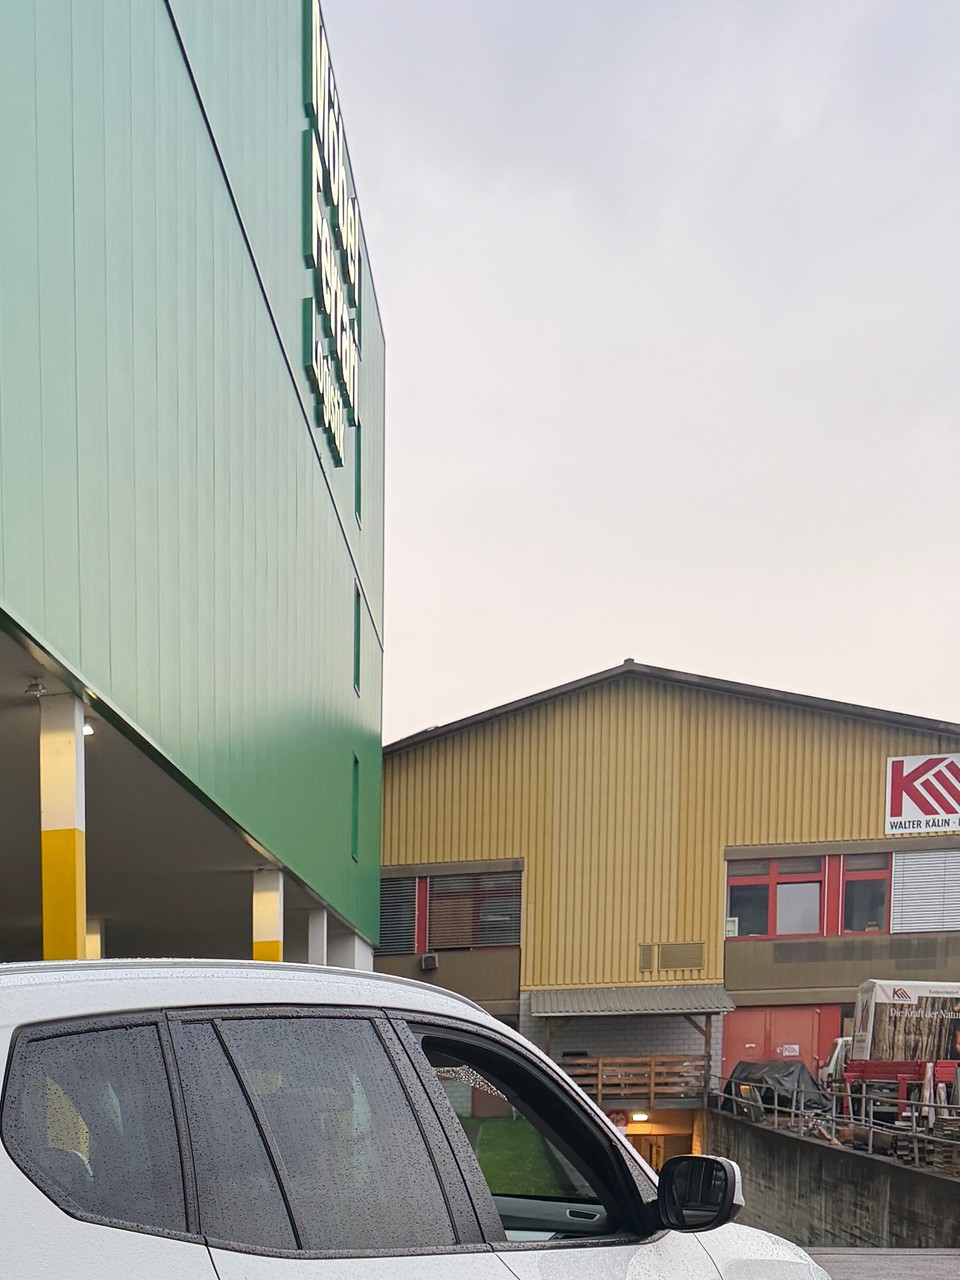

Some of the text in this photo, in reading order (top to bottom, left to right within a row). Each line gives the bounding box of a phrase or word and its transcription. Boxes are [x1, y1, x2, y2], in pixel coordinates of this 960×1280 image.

[312, 0, 359, 307] Möbel
[312, 130, 359, 426] Ferrari
[312, 298, 345, 466] Logistik
[890, 819, 922, 830] WALTER
[925, 817, 951, 828] KÄLIN
[890, 1007, 904, 1017] Die
[905, 1007, 924, 1018] Kraft
[925, 1009, 939, 1019] der
